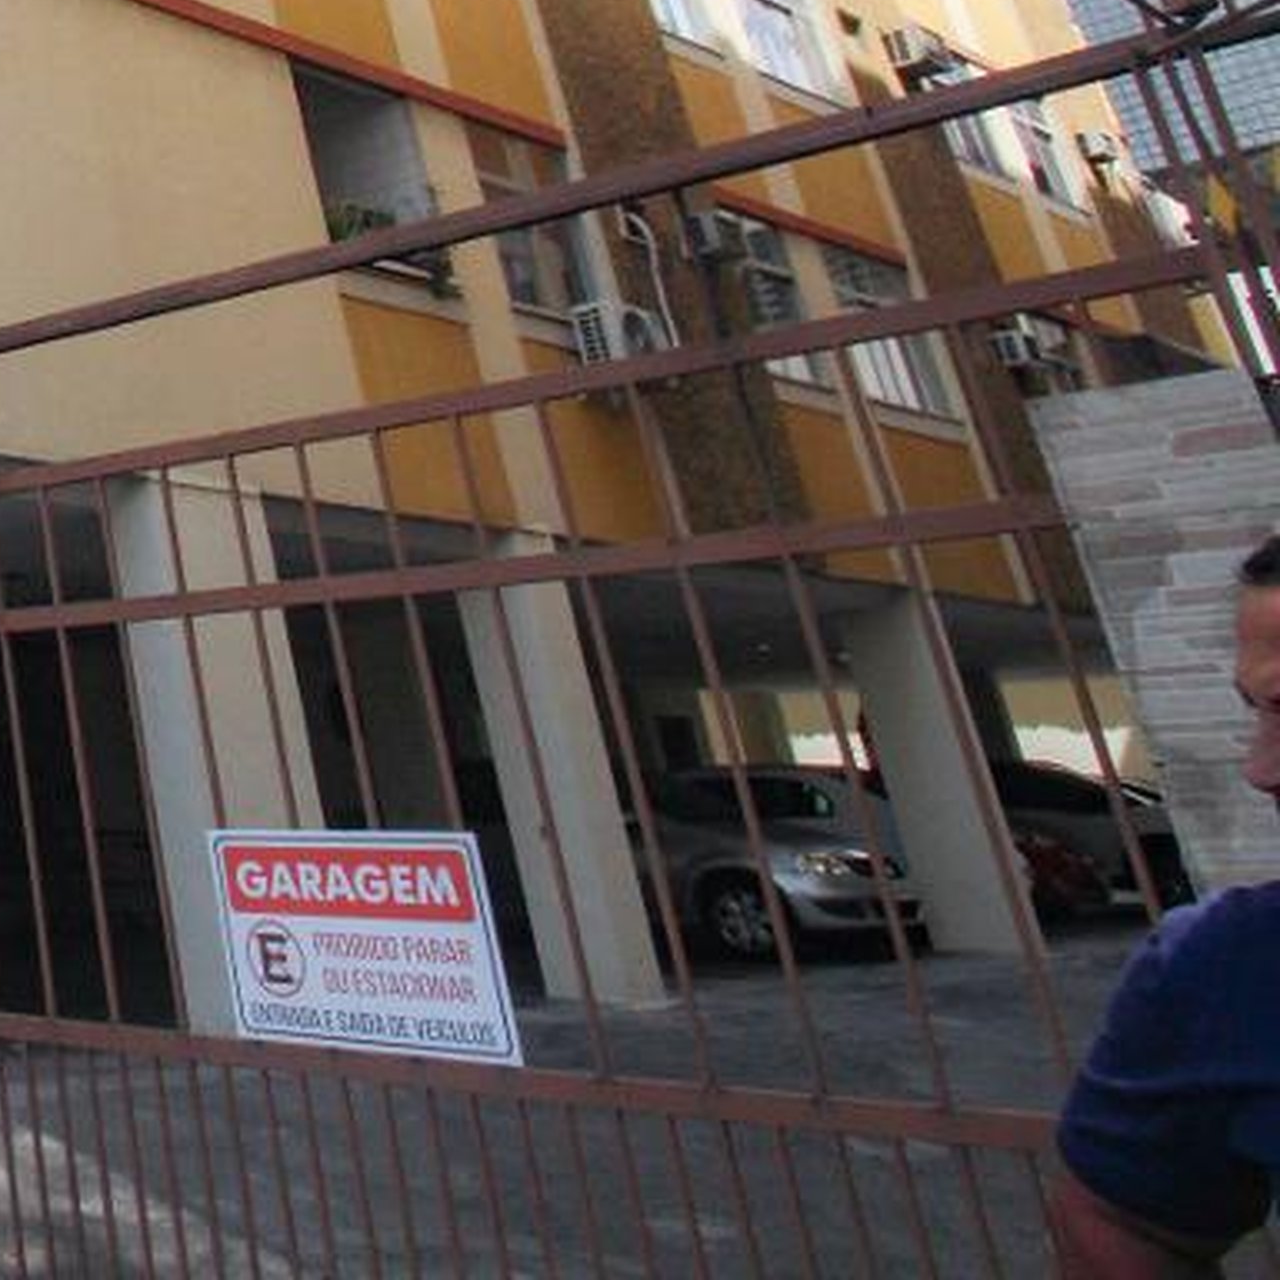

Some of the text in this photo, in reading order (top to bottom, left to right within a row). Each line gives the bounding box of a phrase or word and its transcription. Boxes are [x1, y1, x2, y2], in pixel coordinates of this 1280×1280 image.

[236, 861, 460, 906] GARAGEM
[258, 933, 294, 983] E
[401, 936, 473, 966] PARAR
[324, 967, 478, 1005] OU ESTACIONAR
